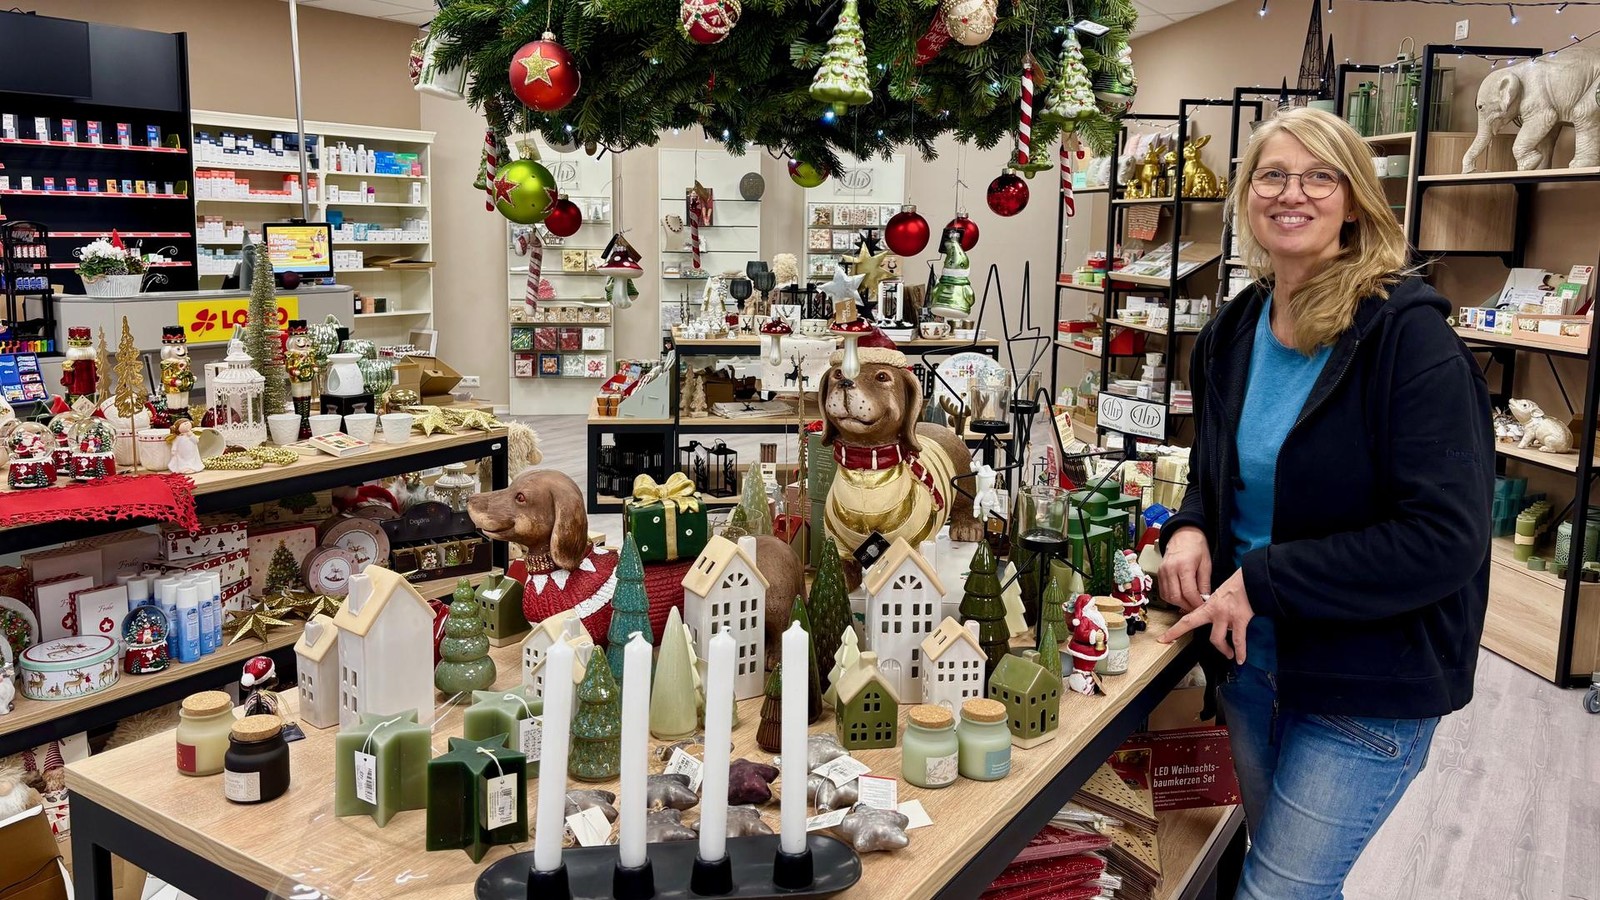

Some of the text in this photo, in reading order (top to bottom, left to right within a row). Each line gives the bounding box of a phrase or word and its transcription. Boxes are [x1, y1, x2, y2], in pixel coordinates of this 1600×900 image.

[221, 306, 289, 330] LOO
[1154, 763, 1220, 777] LED Weihnachts-
[1153, 774, 1216, 788] baumkerzen Set
